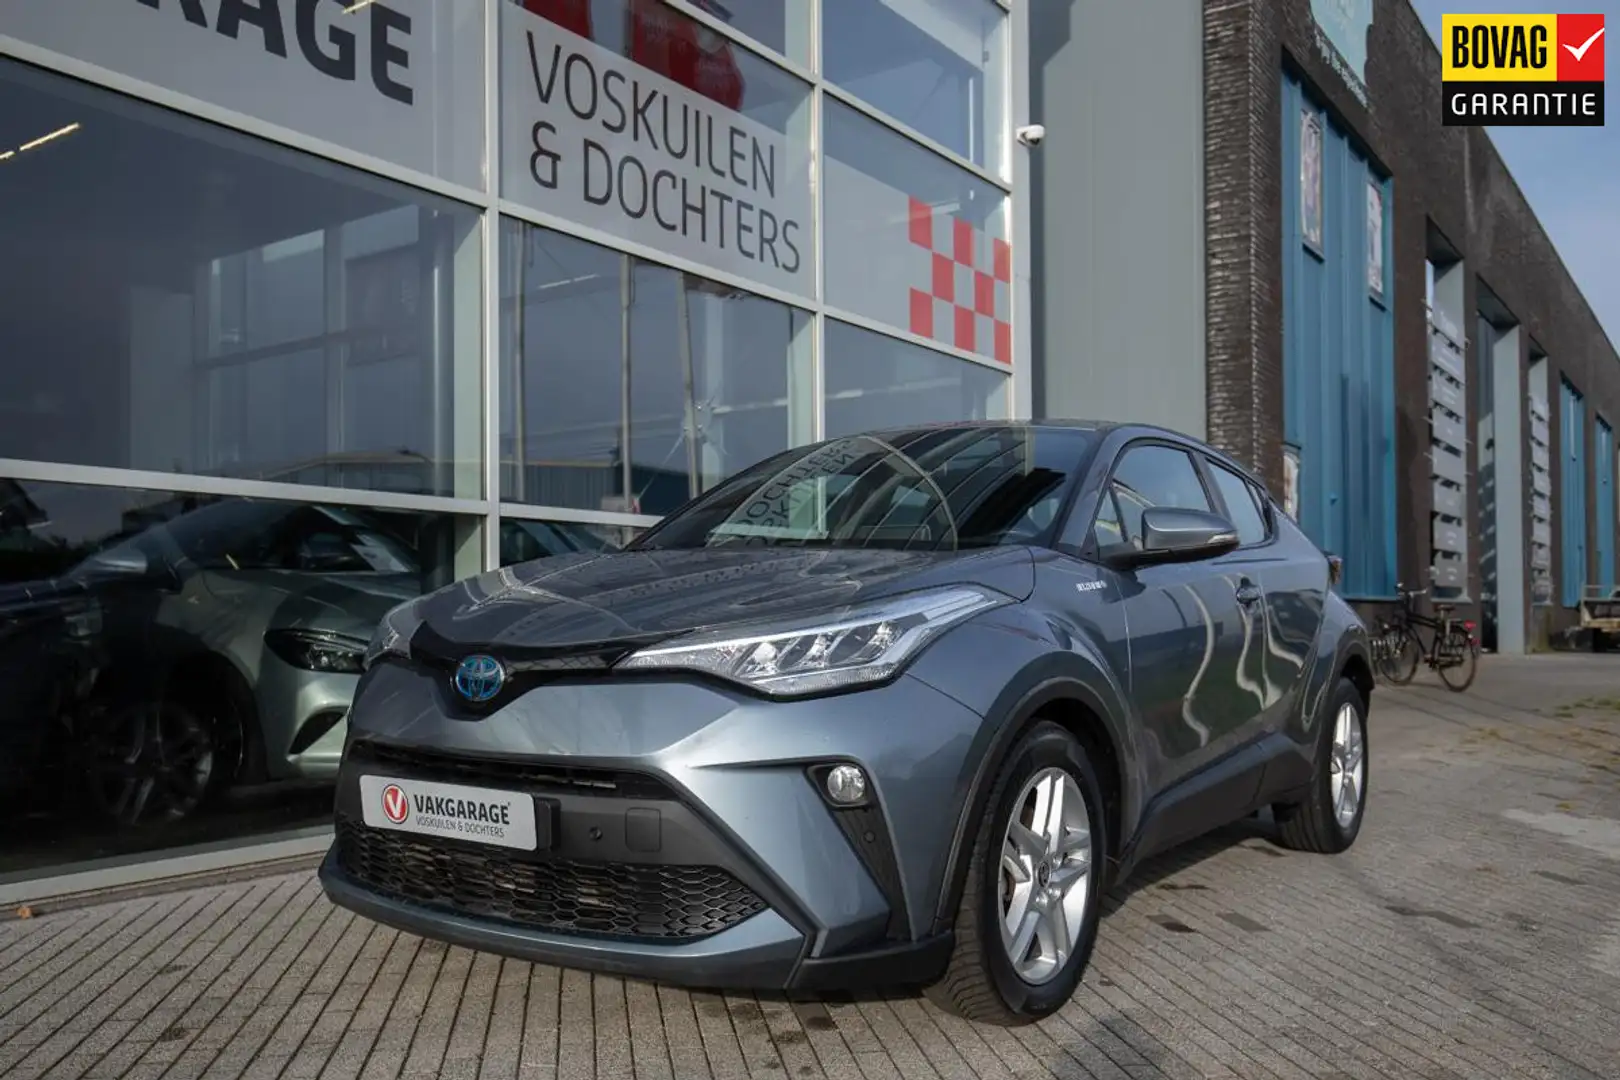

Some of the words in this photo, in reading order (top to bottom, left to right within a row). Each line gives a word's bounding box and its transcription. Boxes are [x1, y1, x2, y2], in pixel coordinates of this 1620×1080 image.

[135, 0, 413, 105] AGE
[527, 30, 775, 198] VOSKUILEN
[530, 121, 561, 189] &
[583, 138, 800, 273] DOCHTERS
[414, 795, 509, 825] VAKGARAGE
[416, 815, 456, 831] VOSKUILEN
[458, 820, 463, 832] &
[465, 822, 504, 838] DOCHTERS
